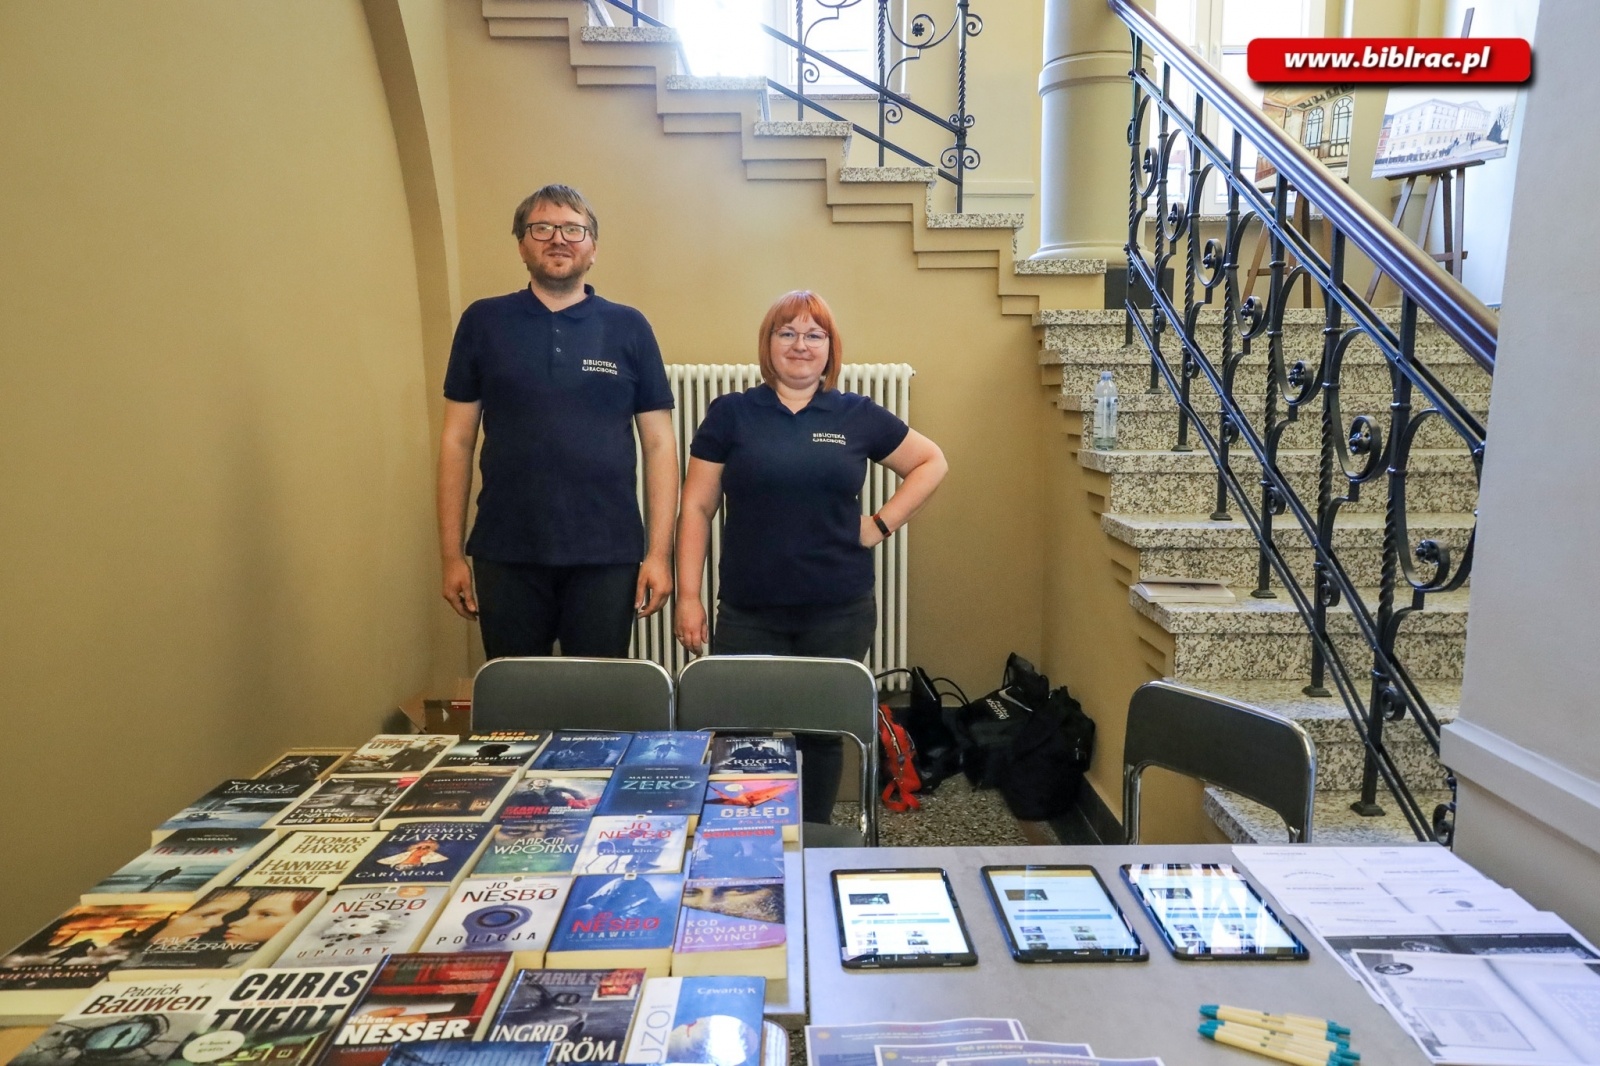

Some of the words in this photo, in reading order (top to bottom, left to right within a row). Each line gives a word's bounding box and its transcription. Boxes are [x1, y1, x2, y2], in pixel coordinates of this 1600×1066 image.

[582, 359, 617, 369] BIBLIOTEKA
[812, 432, 846, 440] BIBLIOTEKA
[620, 780, 700, 790] ZERO
[720, 806, 790, 819] OBŁĘD
[404, 826, 474, 834] THOMAS
[622, 822, 651, 831] JO
[303, 835, 370, 845] THOMAS
[388, 833, 478, 842] HARRIS
[598, 829, 673, 840] NESBØ
[513, 837, 565, 845] MARCIN
[291, 843, 362, 854] HARRIS
[260, 859, 350, 871] HANNIBAL
[355, 870, 394, 878] CARI
[399, 869, 445, 877] MORA
[263, 875, 318, 885] MASKI
[485, 881, 509, 890] JO
[359, 892, 382, 900] JO
[460, 887, 560, 903] NESBØ
[332, 897, 430, 913] NESBØ
[571, 917, 661, 933] NESBØ
[685, 923, 769, 935] LEONARDA
[686, 919, 718, 928] KOD
[436, 932, 537, 946] POLICJA
[684, 935, 705, 944] DA
[713, 932, 758, 942] VINCI
[297, 946, 391, 959] UPIORY
[121, 983, 182, 998] Patrick
[228, 968, 369, 1002] CHRIS
[697, 986, 745, 996] Czwarty
[80, 994, 213, 1016] Bauwen
[207, 1003, 348, 1035] TVEDT
[347, 1014, 394, 1024] Håkan
[334, 1018, 471, 1046] NESSER
[489, 1024, 569, 1042] INGRID
